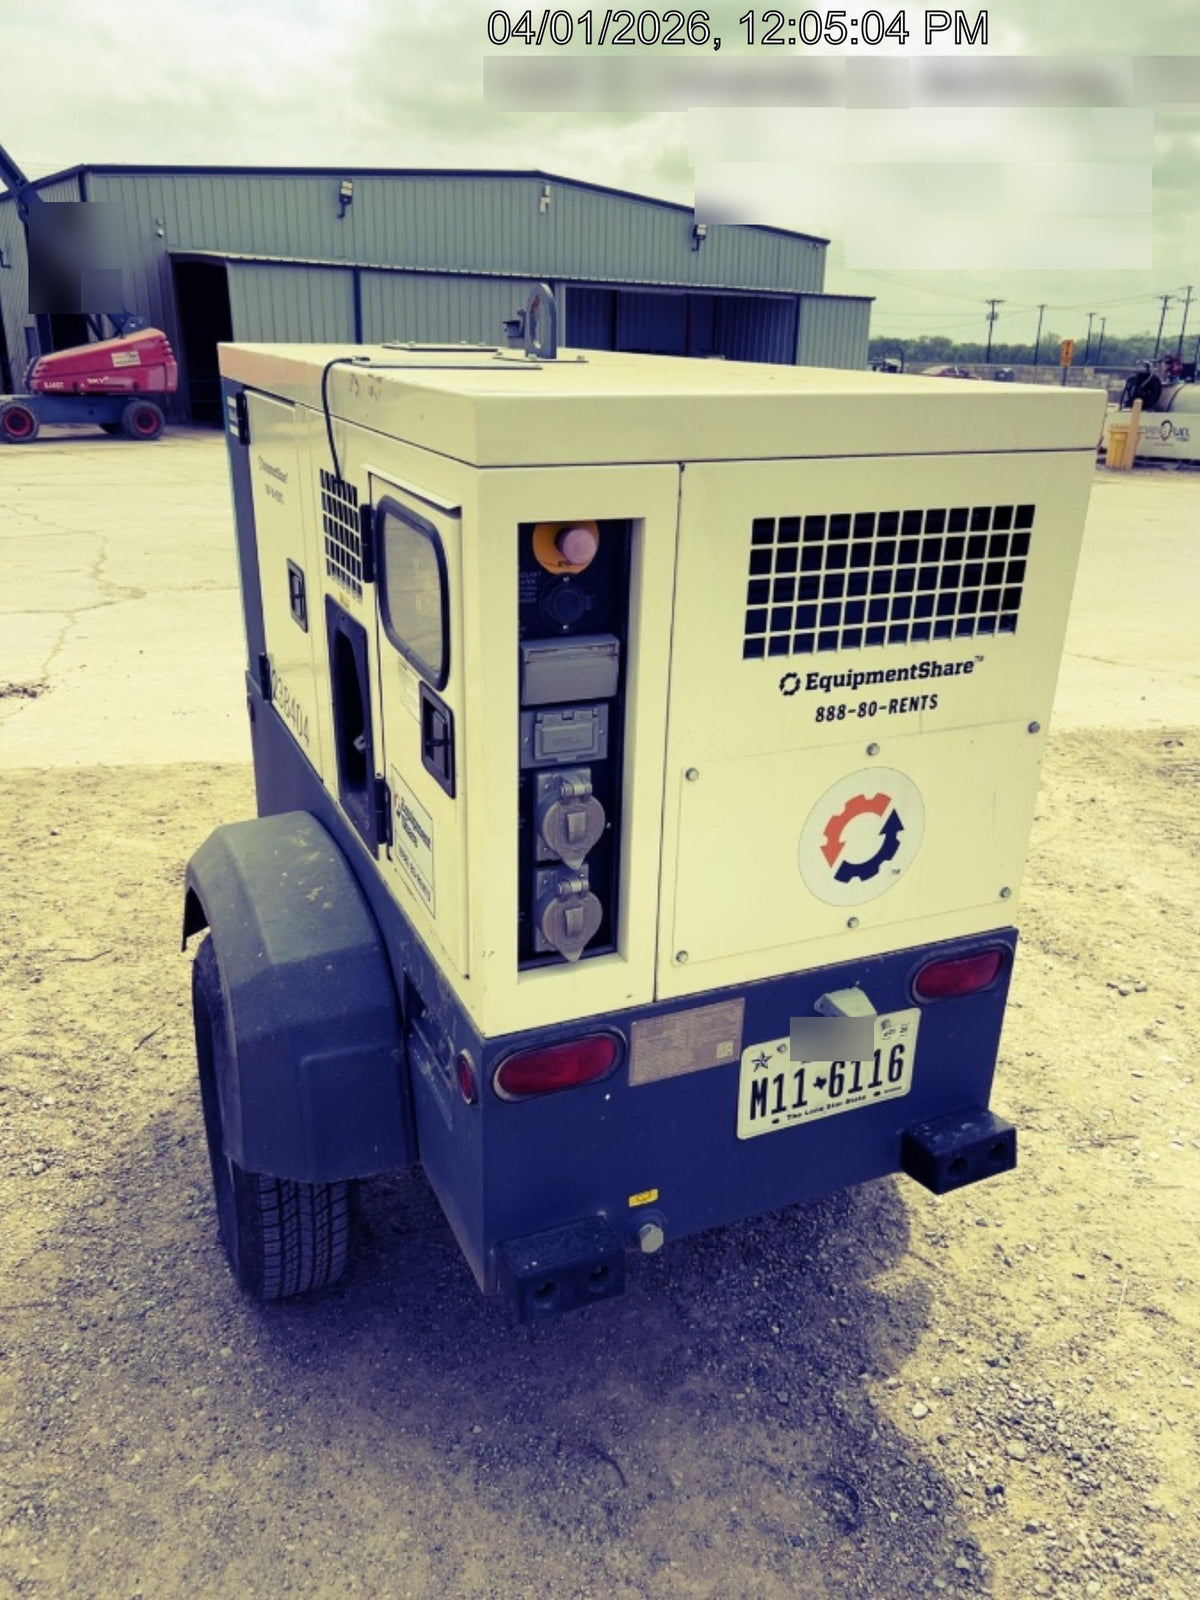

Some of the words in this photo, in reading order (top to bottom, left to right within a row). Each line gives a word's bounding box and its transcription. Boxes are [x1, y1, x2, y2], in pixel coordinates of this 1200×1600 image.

[805, 659, 974, 693] EquipmentShare
[814, 693, 939, 723] 888-80-RENTS
[750, 1067, 808, 1121] M11
[828, 1043, 906, 1098] 6116
